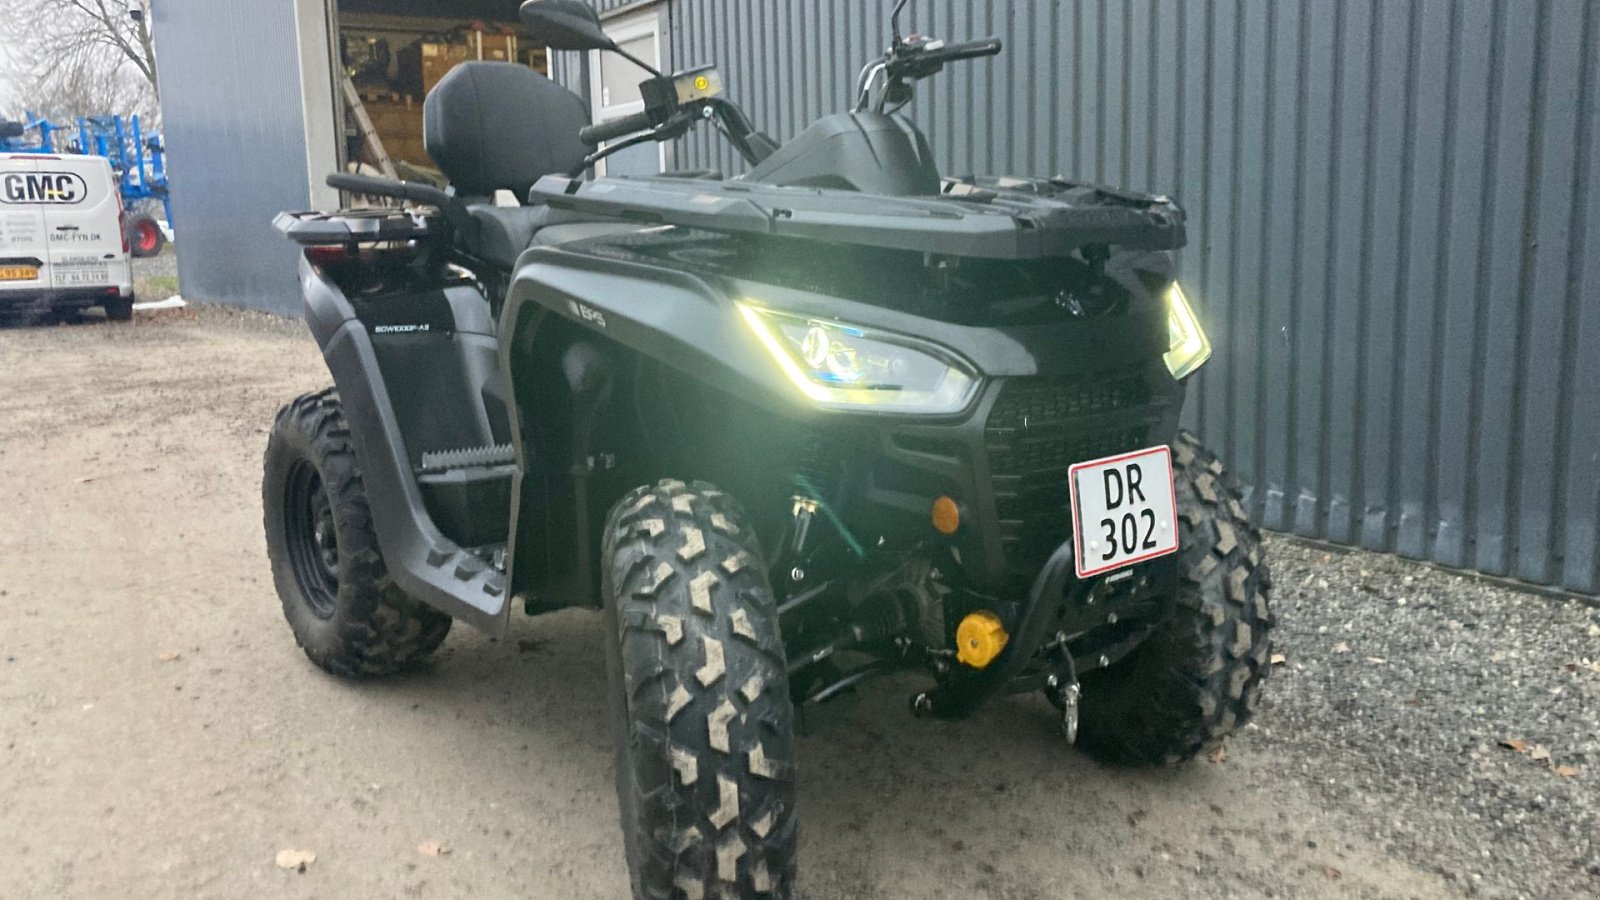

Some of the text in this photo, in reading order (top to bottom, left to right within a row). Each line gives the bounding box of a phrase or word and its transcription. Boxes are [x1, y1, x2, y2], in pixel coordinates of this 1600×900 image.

[4, 174, 75, 201] GMC
[1103, 463, 1146, 511] DR
[1100, 508, 1157, 561] 302
